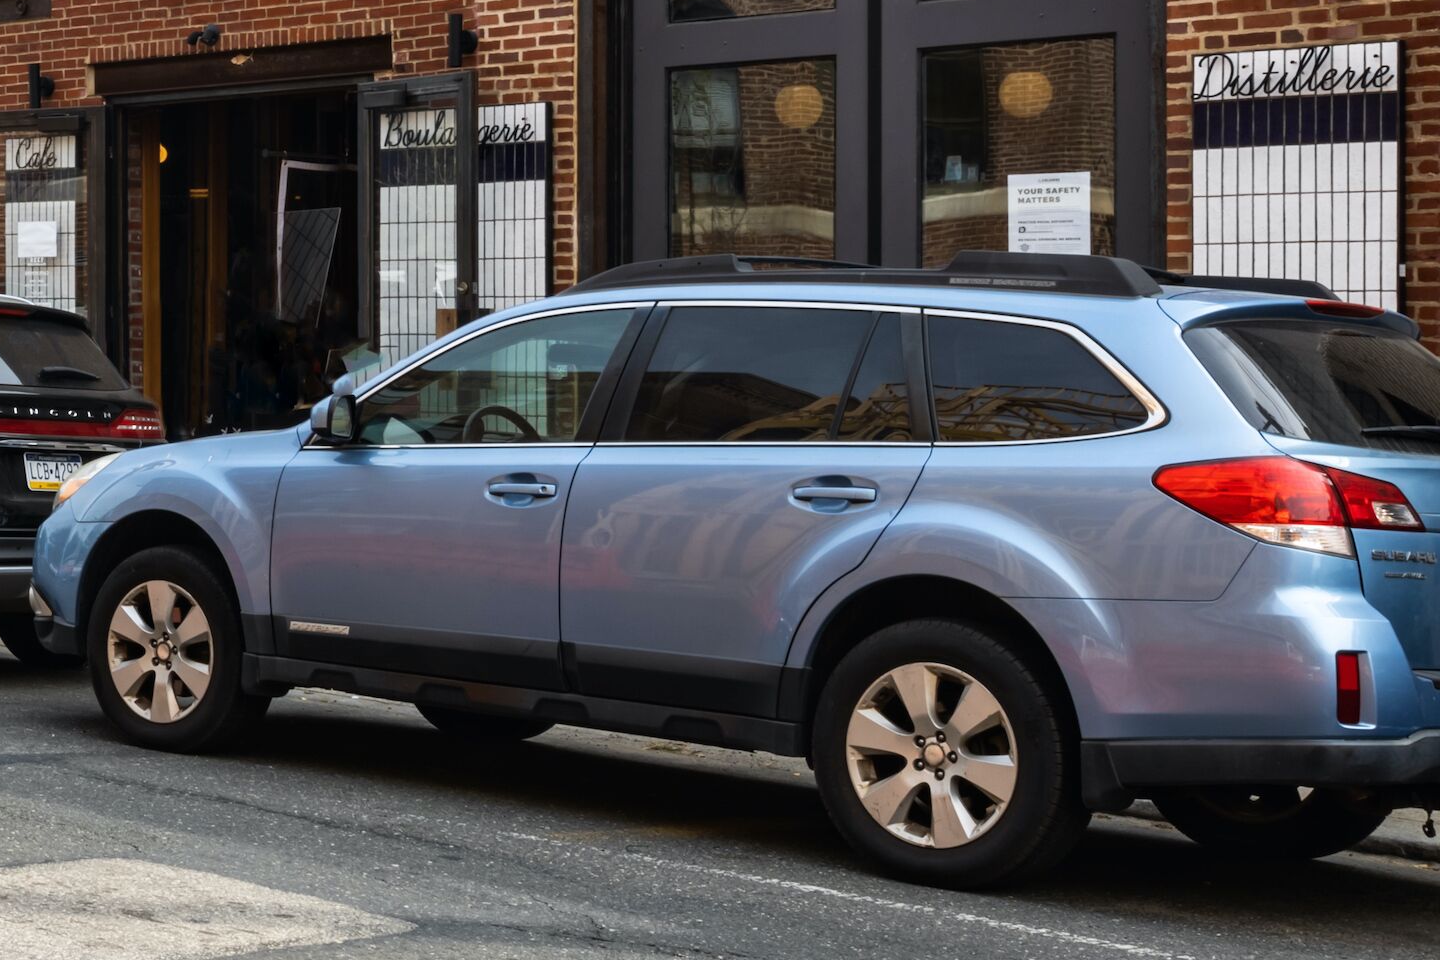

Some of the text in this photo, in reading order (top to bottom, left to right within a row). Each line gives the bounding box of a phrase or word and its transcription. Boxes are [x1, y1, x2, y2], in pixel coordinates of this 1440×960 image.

[1192, 46, 1395, 100] Distillerie
[1045, 186, 1081, 194] SAFETY
[1017, 196, 1061, 204] MATTERS
[1371, 548, 1438, 565] SUBARU
